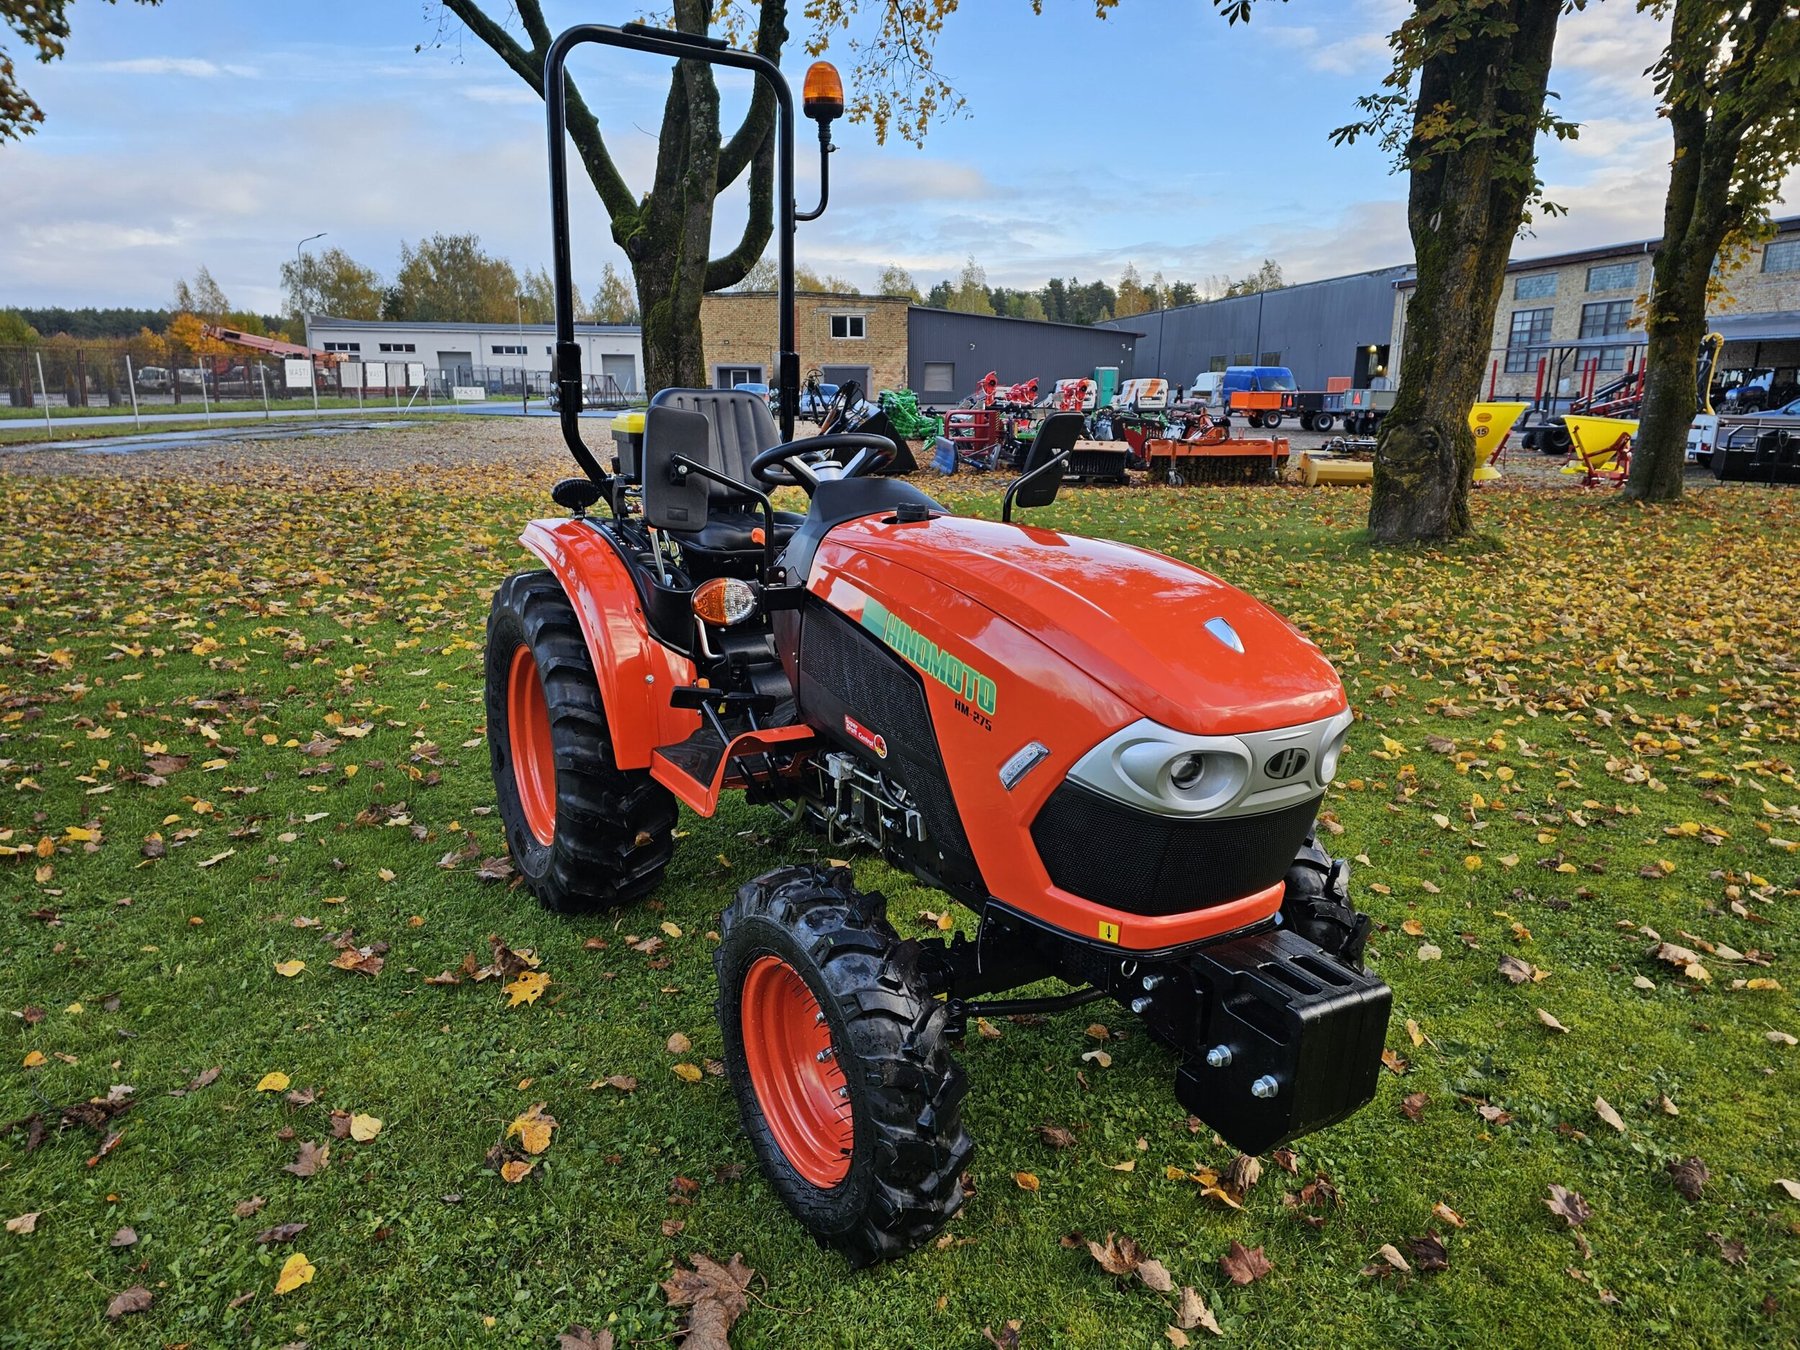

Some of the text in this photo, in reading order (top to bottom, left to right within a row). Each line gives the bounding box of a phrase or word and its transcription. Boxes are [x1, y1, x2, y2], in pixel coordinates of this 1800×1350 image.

[883, 612, 997, 716] HINOMOTO
[954, 698, 992, 732] HM-275
[858, 732, 874, 747] Control
